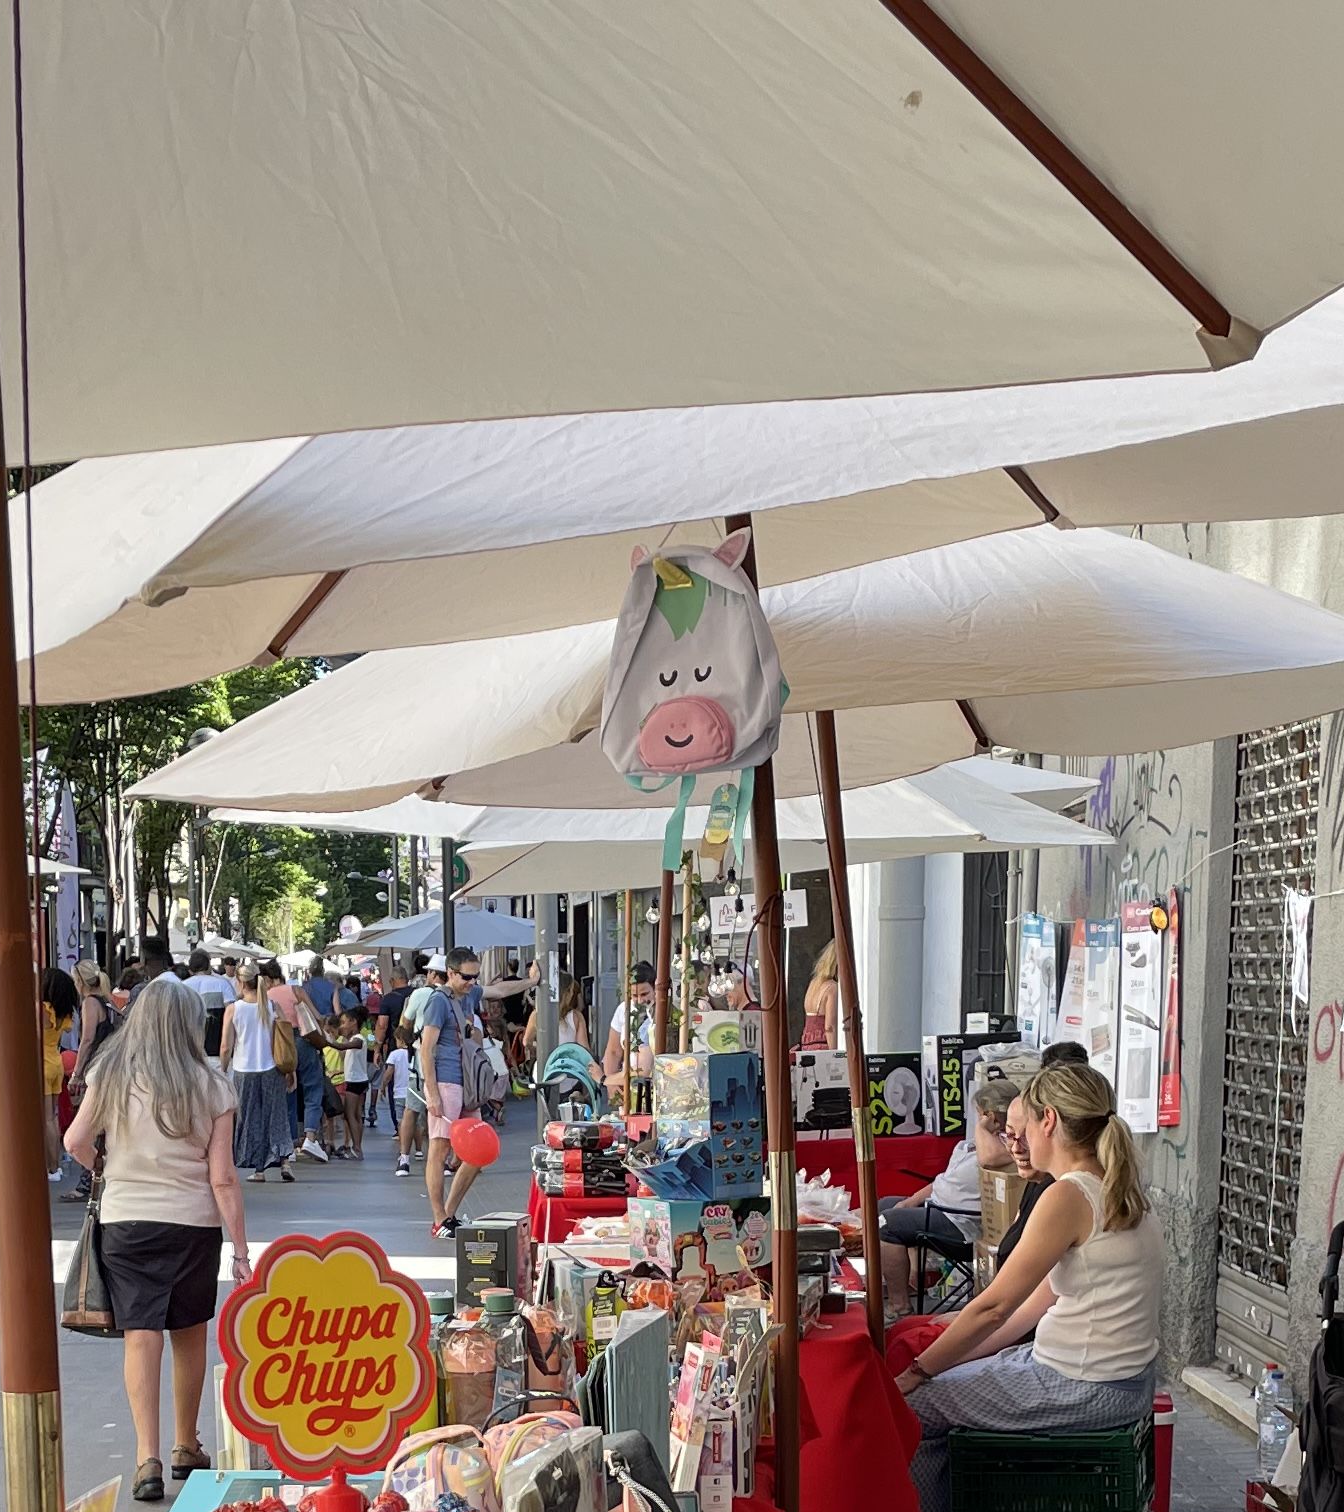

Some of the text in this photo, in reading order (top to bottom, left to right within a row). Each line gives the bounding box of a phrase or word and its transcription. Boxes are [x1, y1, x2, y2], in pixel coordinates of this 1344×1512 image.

[869, 1079, 893, 1135] S23
[943, 1058, 962, 1133] VTS45
[706, 1206, 728, 1218] CRY
[257, 1295, 401, 1358] Chupa
[253, 1349, 398, 1437] Chups
